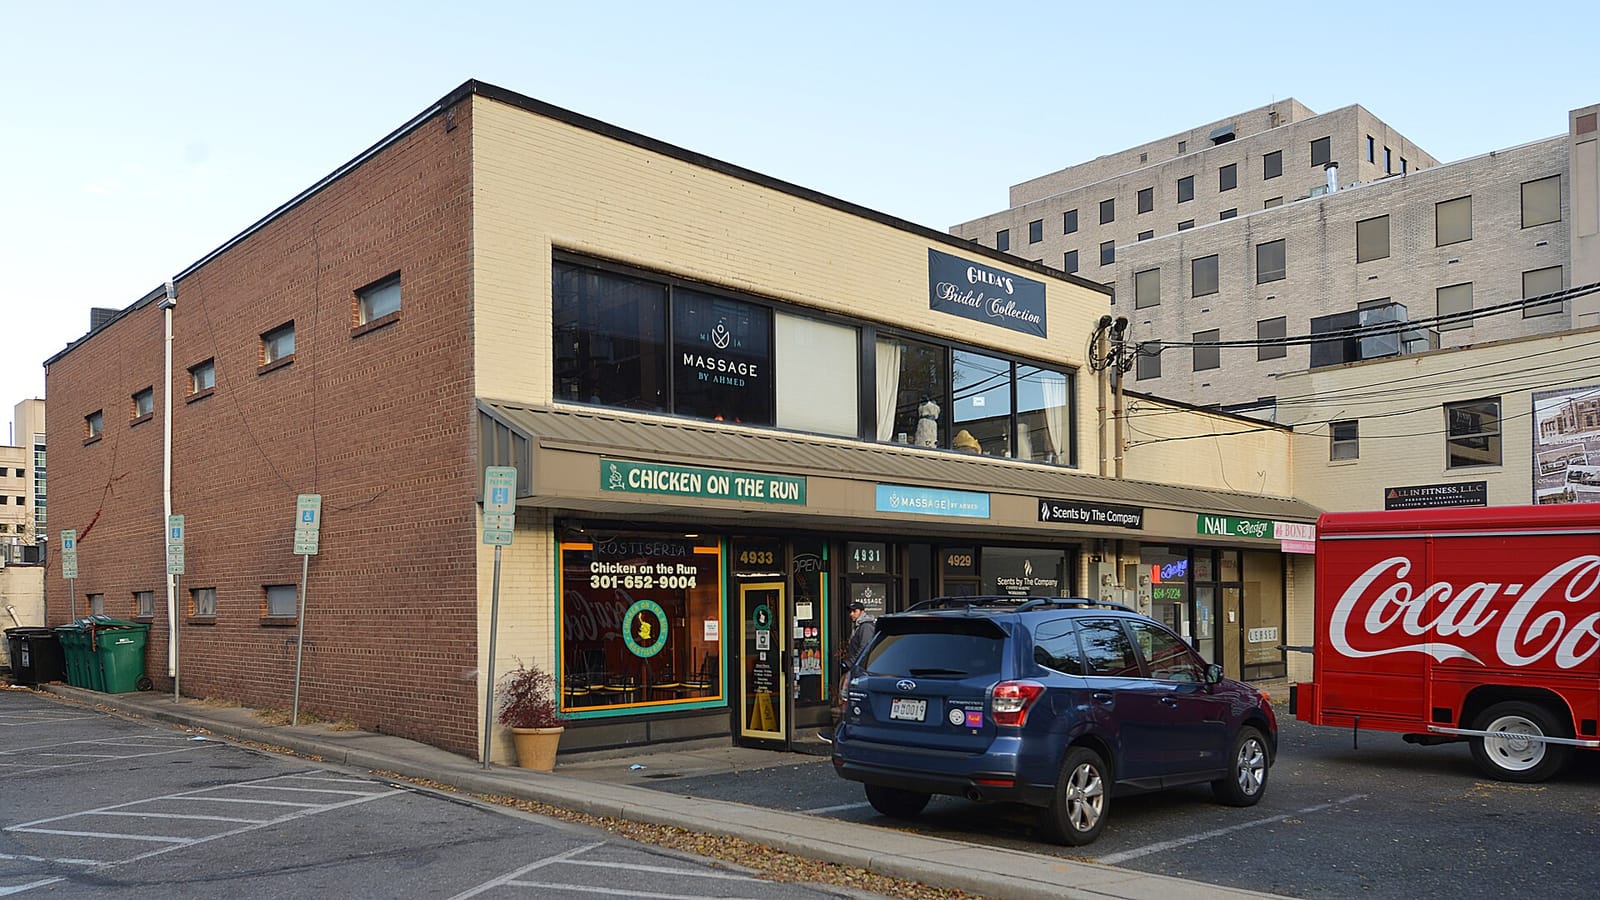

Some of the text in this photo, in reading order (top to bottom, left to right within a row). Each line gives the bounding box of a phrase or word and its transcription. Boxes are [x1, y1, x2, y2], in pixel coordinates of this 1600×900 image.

[966, 266, 1014, 295] GILDA'S
[936, 281, 1041, 324] Bridal Collection
[683, 353, 758, 377] MASSAGE
[698, 371, 745, 387] BY AHMED
[628, 468, 799, 500] CHICKEN ON THE RUN
[901, 497, 946, 510] MASSAGE
[1052, 506, 1140, 526] Scents by The Company
[1205, 516, 1235, 536] NAIL
[1237, 520, 1268, 537] Design
[1285, 523, 1307, 538] BONE
[740, 551, 774, 564] 4933
[853, 548, 880, 562] 4931
[947, 554, 972, 567] 4929
[590, 561, 697, 575] Chicken on the Run
[793, 558, 822, 573] OPEN
[590, 575, 697, 589] 301-652-9004
[996, 576, 1058, 588] Scents by The Company
